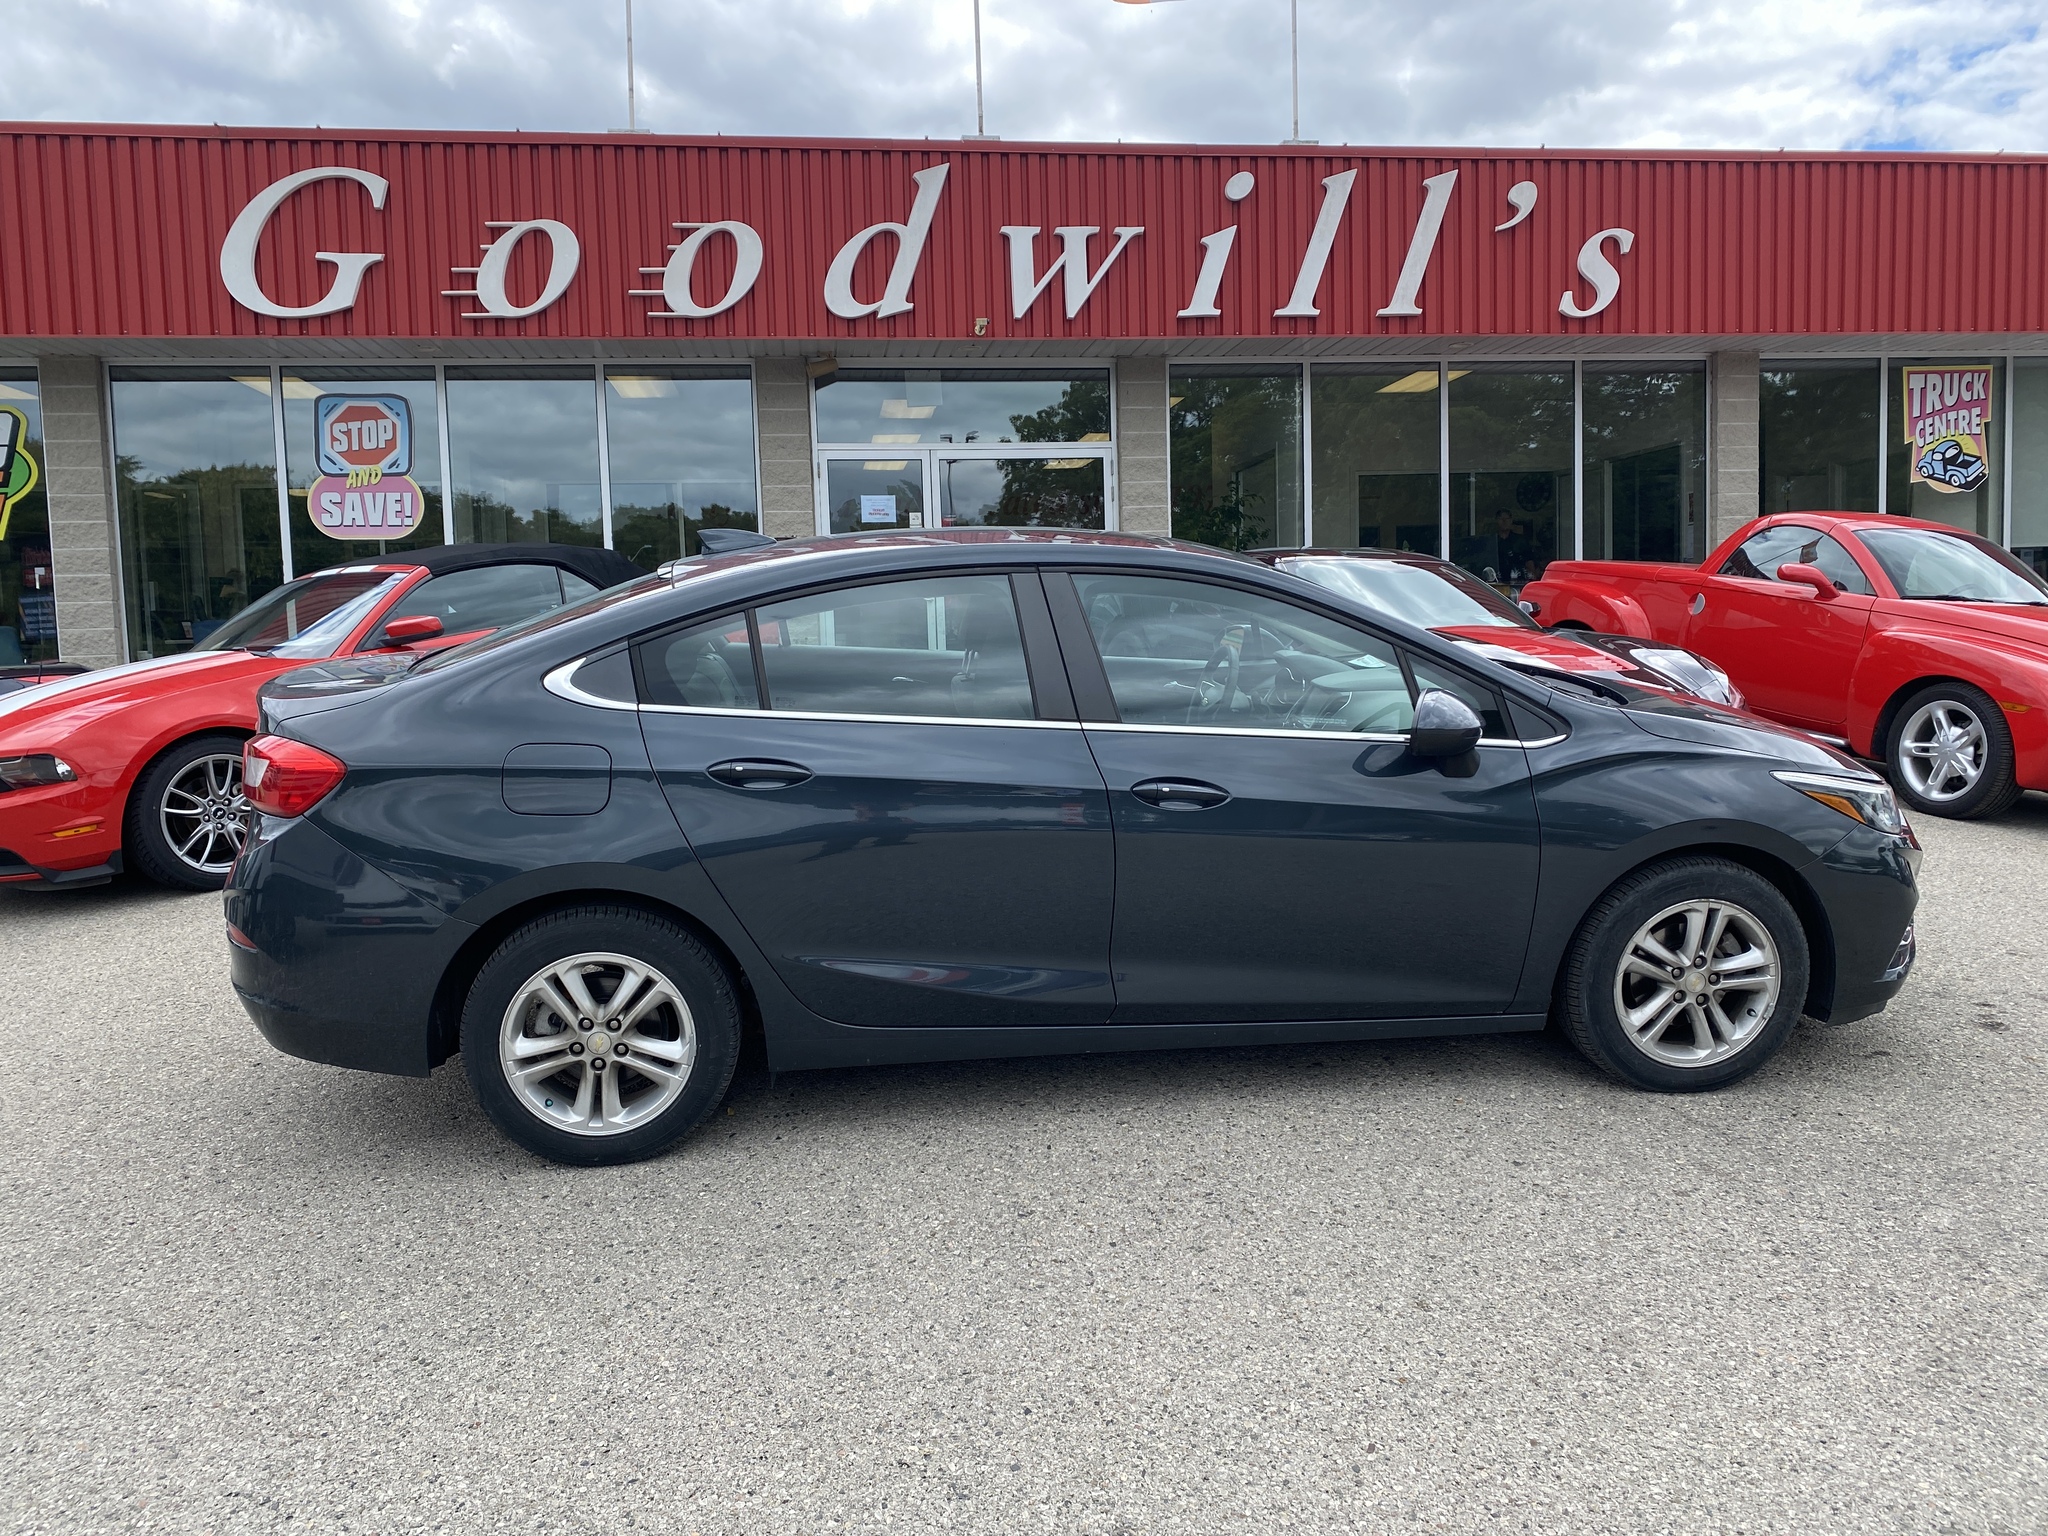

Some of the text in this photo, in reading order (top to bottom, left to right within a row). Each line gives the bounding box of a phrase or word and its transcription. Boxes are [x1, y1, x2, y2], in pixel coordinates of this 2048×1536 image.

[220, 163, 1635, 319] Goodwill's
[1909, 372, 1987, 418] TRUCK
[332, 419, 393, 453] STOP
[1915, 408, 1982, 448] CENTRE
[346, 467, 382, 489] AND
[320, 493, 414, 527] SAVE!
